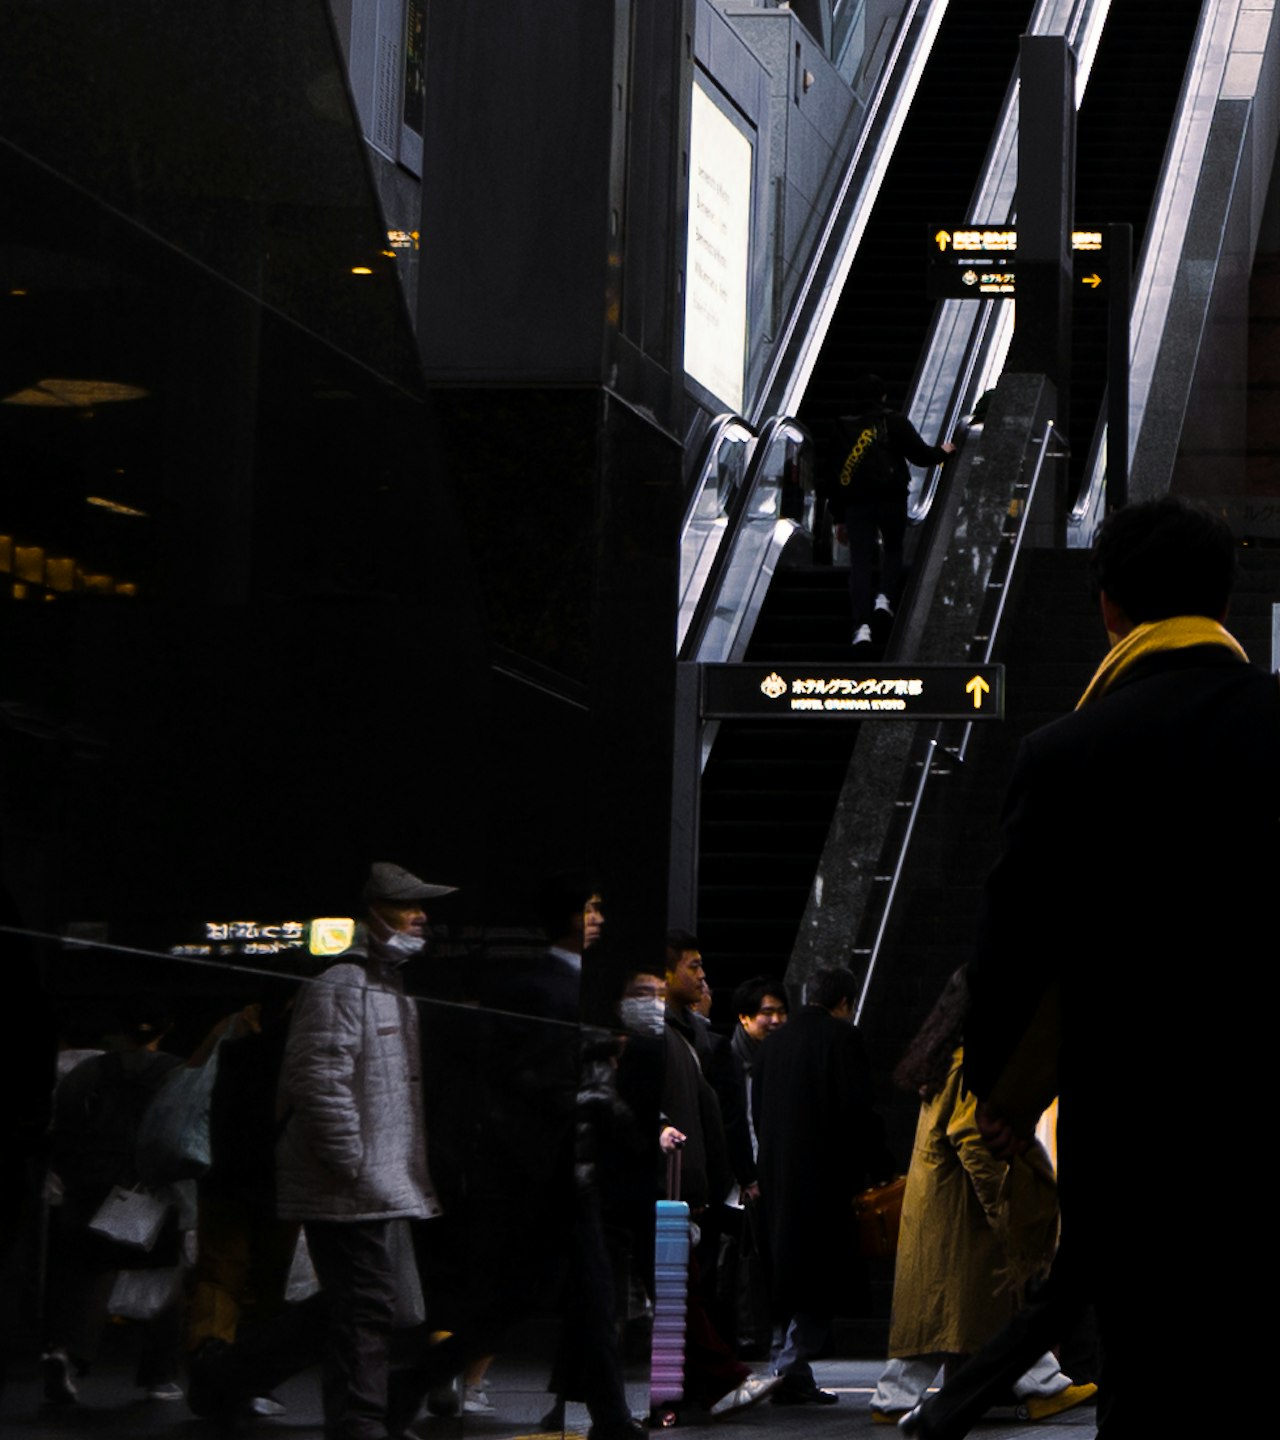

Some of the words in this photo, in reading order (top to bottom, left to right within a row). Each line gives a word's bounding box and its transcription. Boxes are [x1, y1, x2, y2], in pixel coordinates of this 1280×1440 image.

[792, 679, 923, 696] ホテルグランヴィア京都
[791, 698, 824, 710] HOTEL
[871, 699, 906, 710] KYOTO
